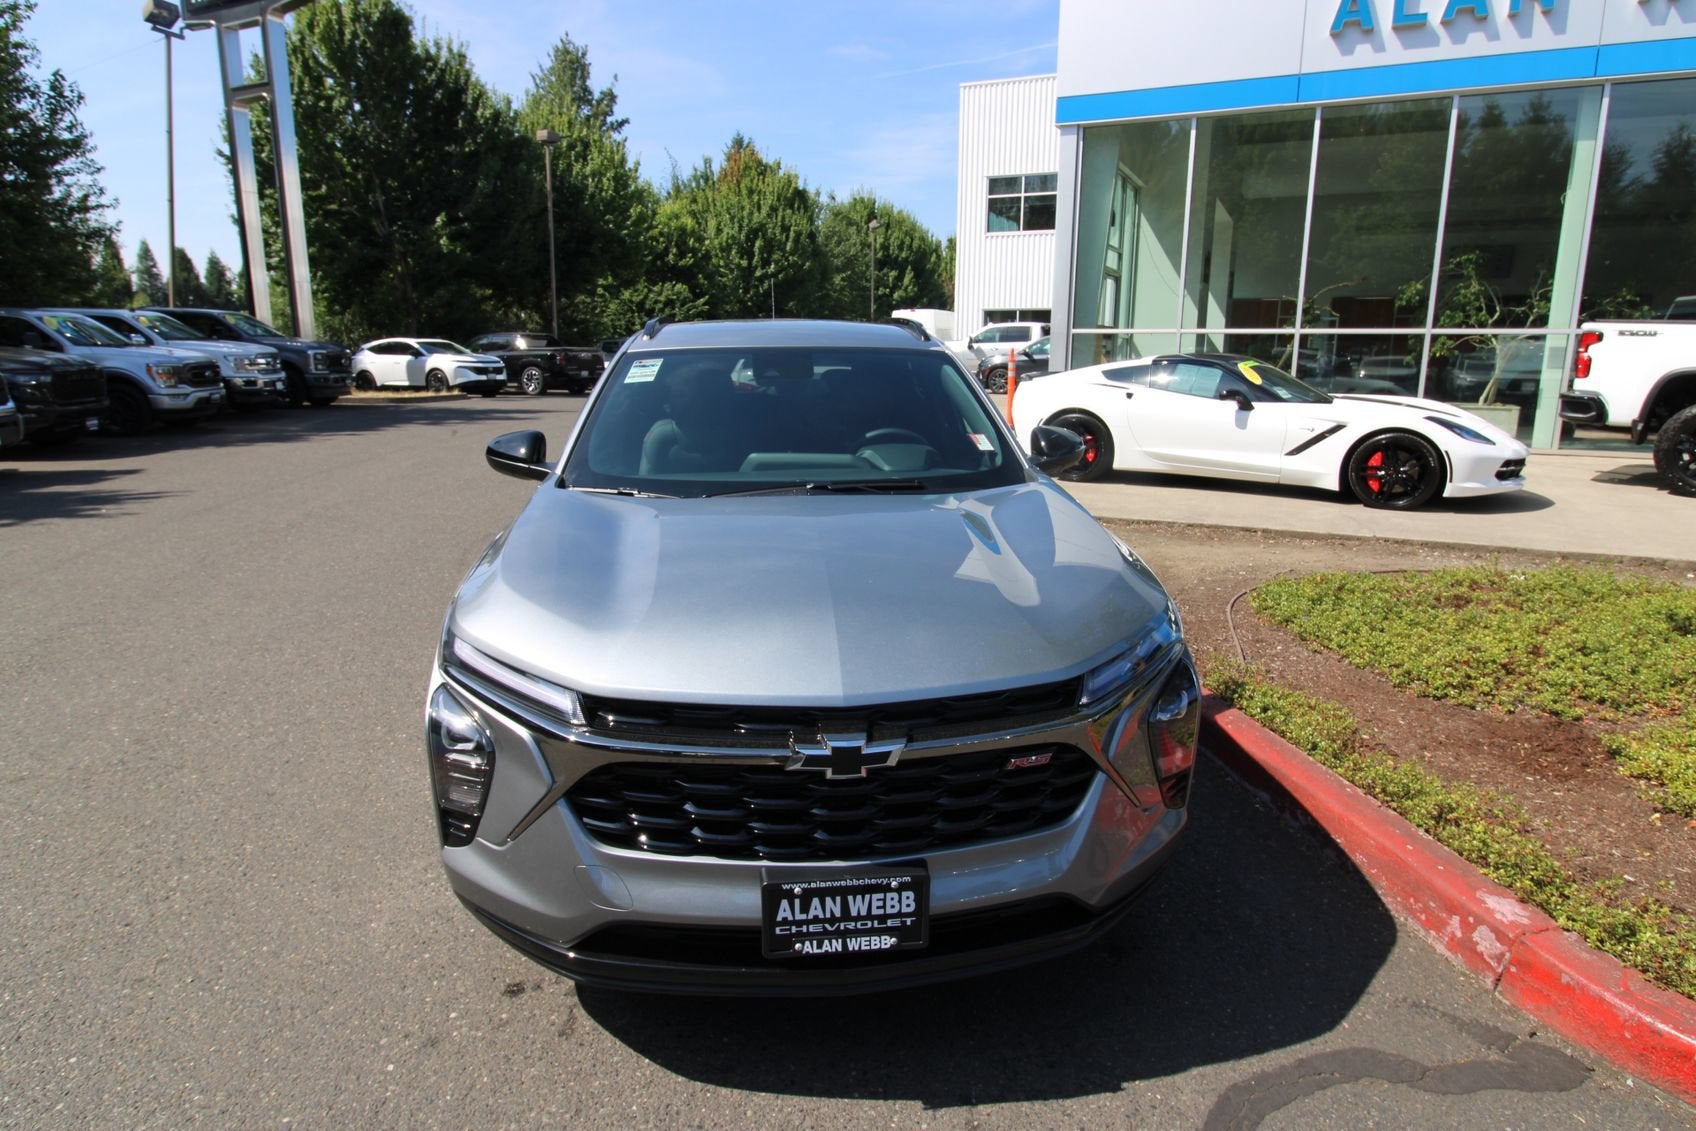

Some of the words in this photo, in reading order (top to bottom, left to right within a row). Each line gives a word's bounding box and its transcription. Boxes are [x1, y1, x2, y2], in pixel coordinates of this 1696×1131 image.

[1007, 753, 1052, 769] RS
[782, 877, 911, 889] www.alanwebbchevy.com
[776, 896, 841, 921] ALAN
[848, 891, 915, 916] WEBB
[775, 917, 916, 934] CHEVROLET
[802, 938, 842, 954] ALAN
[846, 935, 891, 951] WEBB
